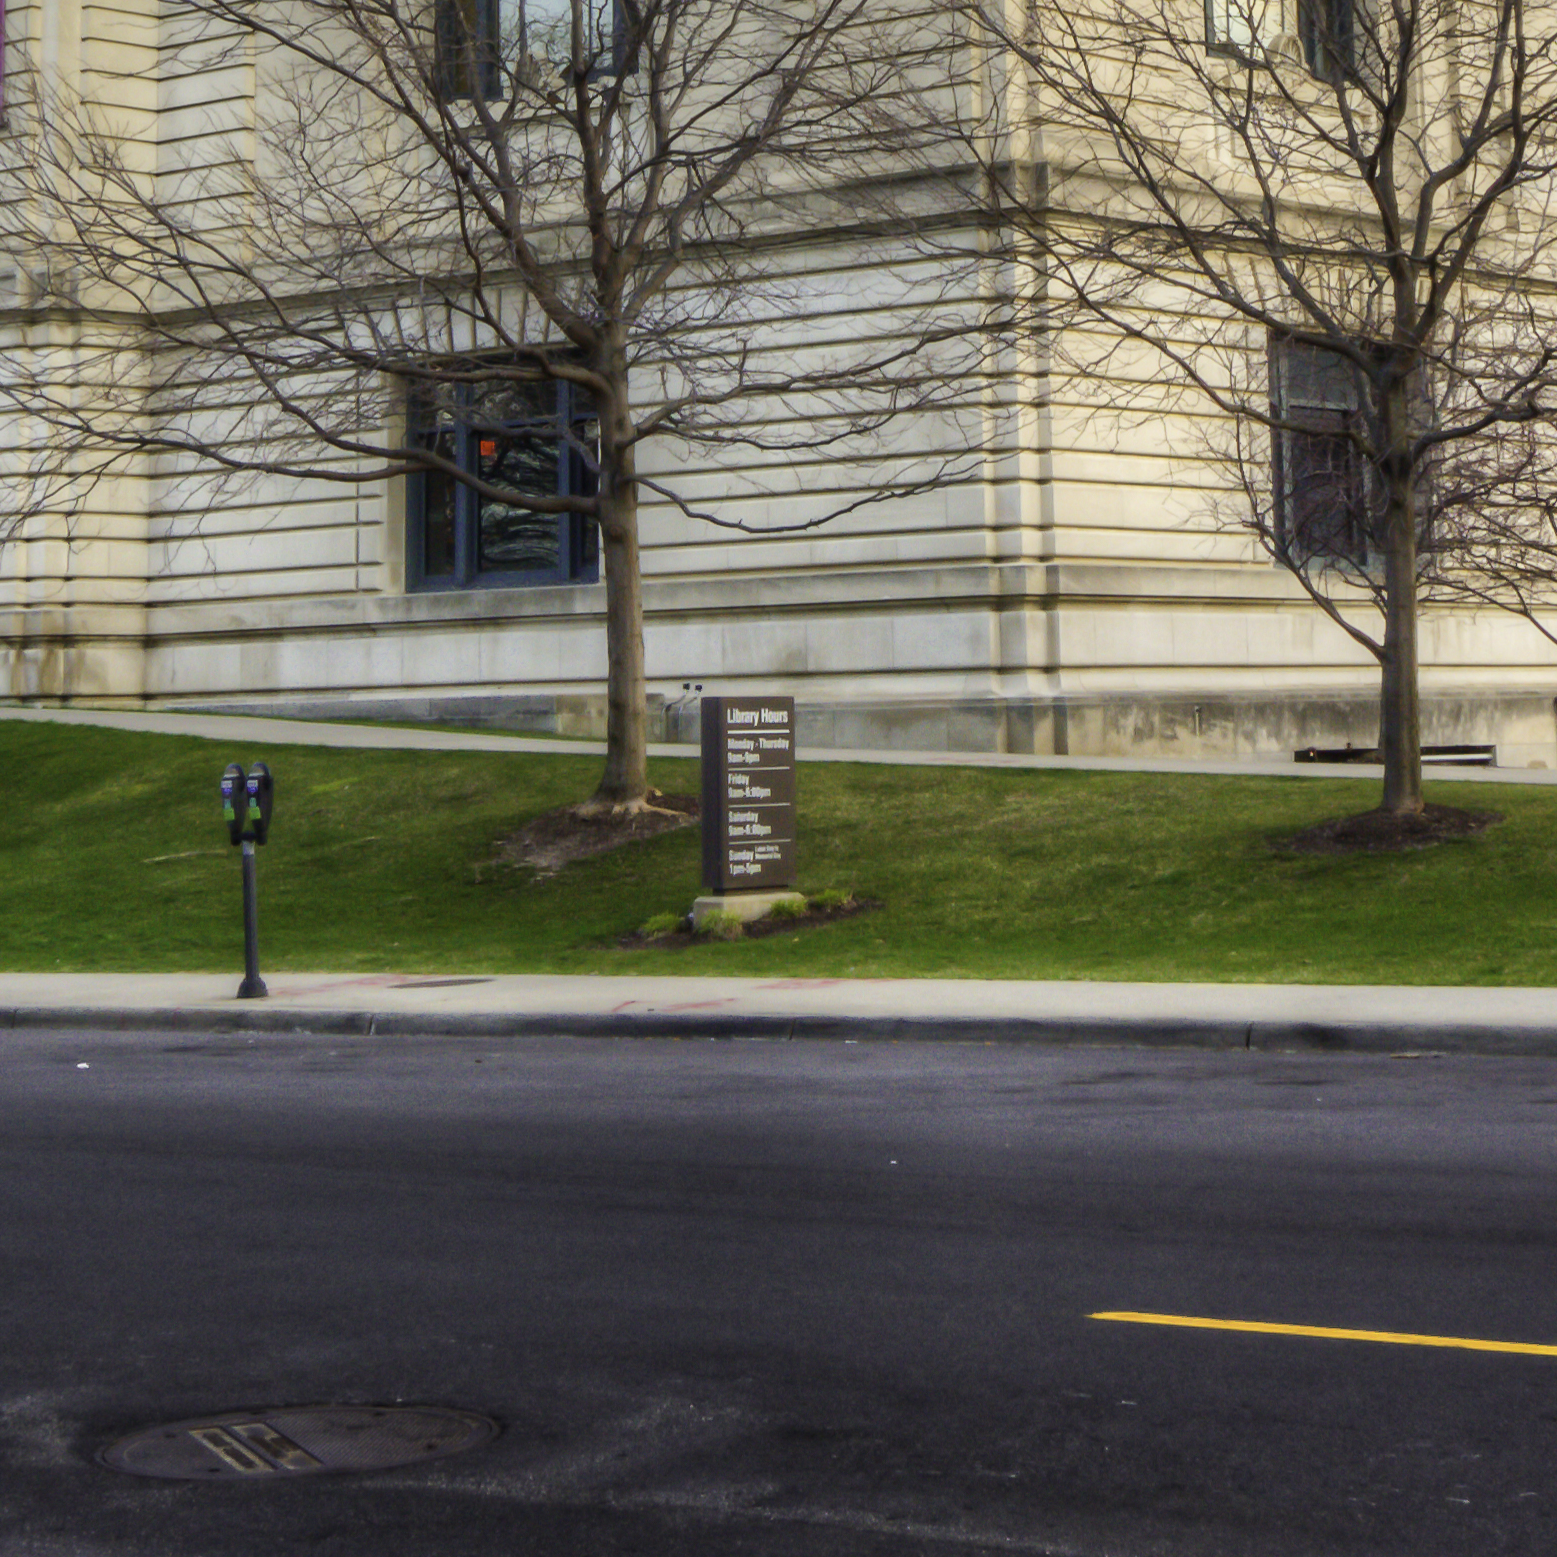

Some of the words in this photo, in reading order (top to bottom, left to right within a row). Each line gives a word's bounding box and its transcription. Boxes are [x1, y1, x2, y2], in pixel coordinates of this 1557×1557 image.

[727, 708, 759, 727] Library
[761, 708, 788, 723] Hours
[759, 738, 789, 751] Thursday
[728, 773, 749, 786] Friday
